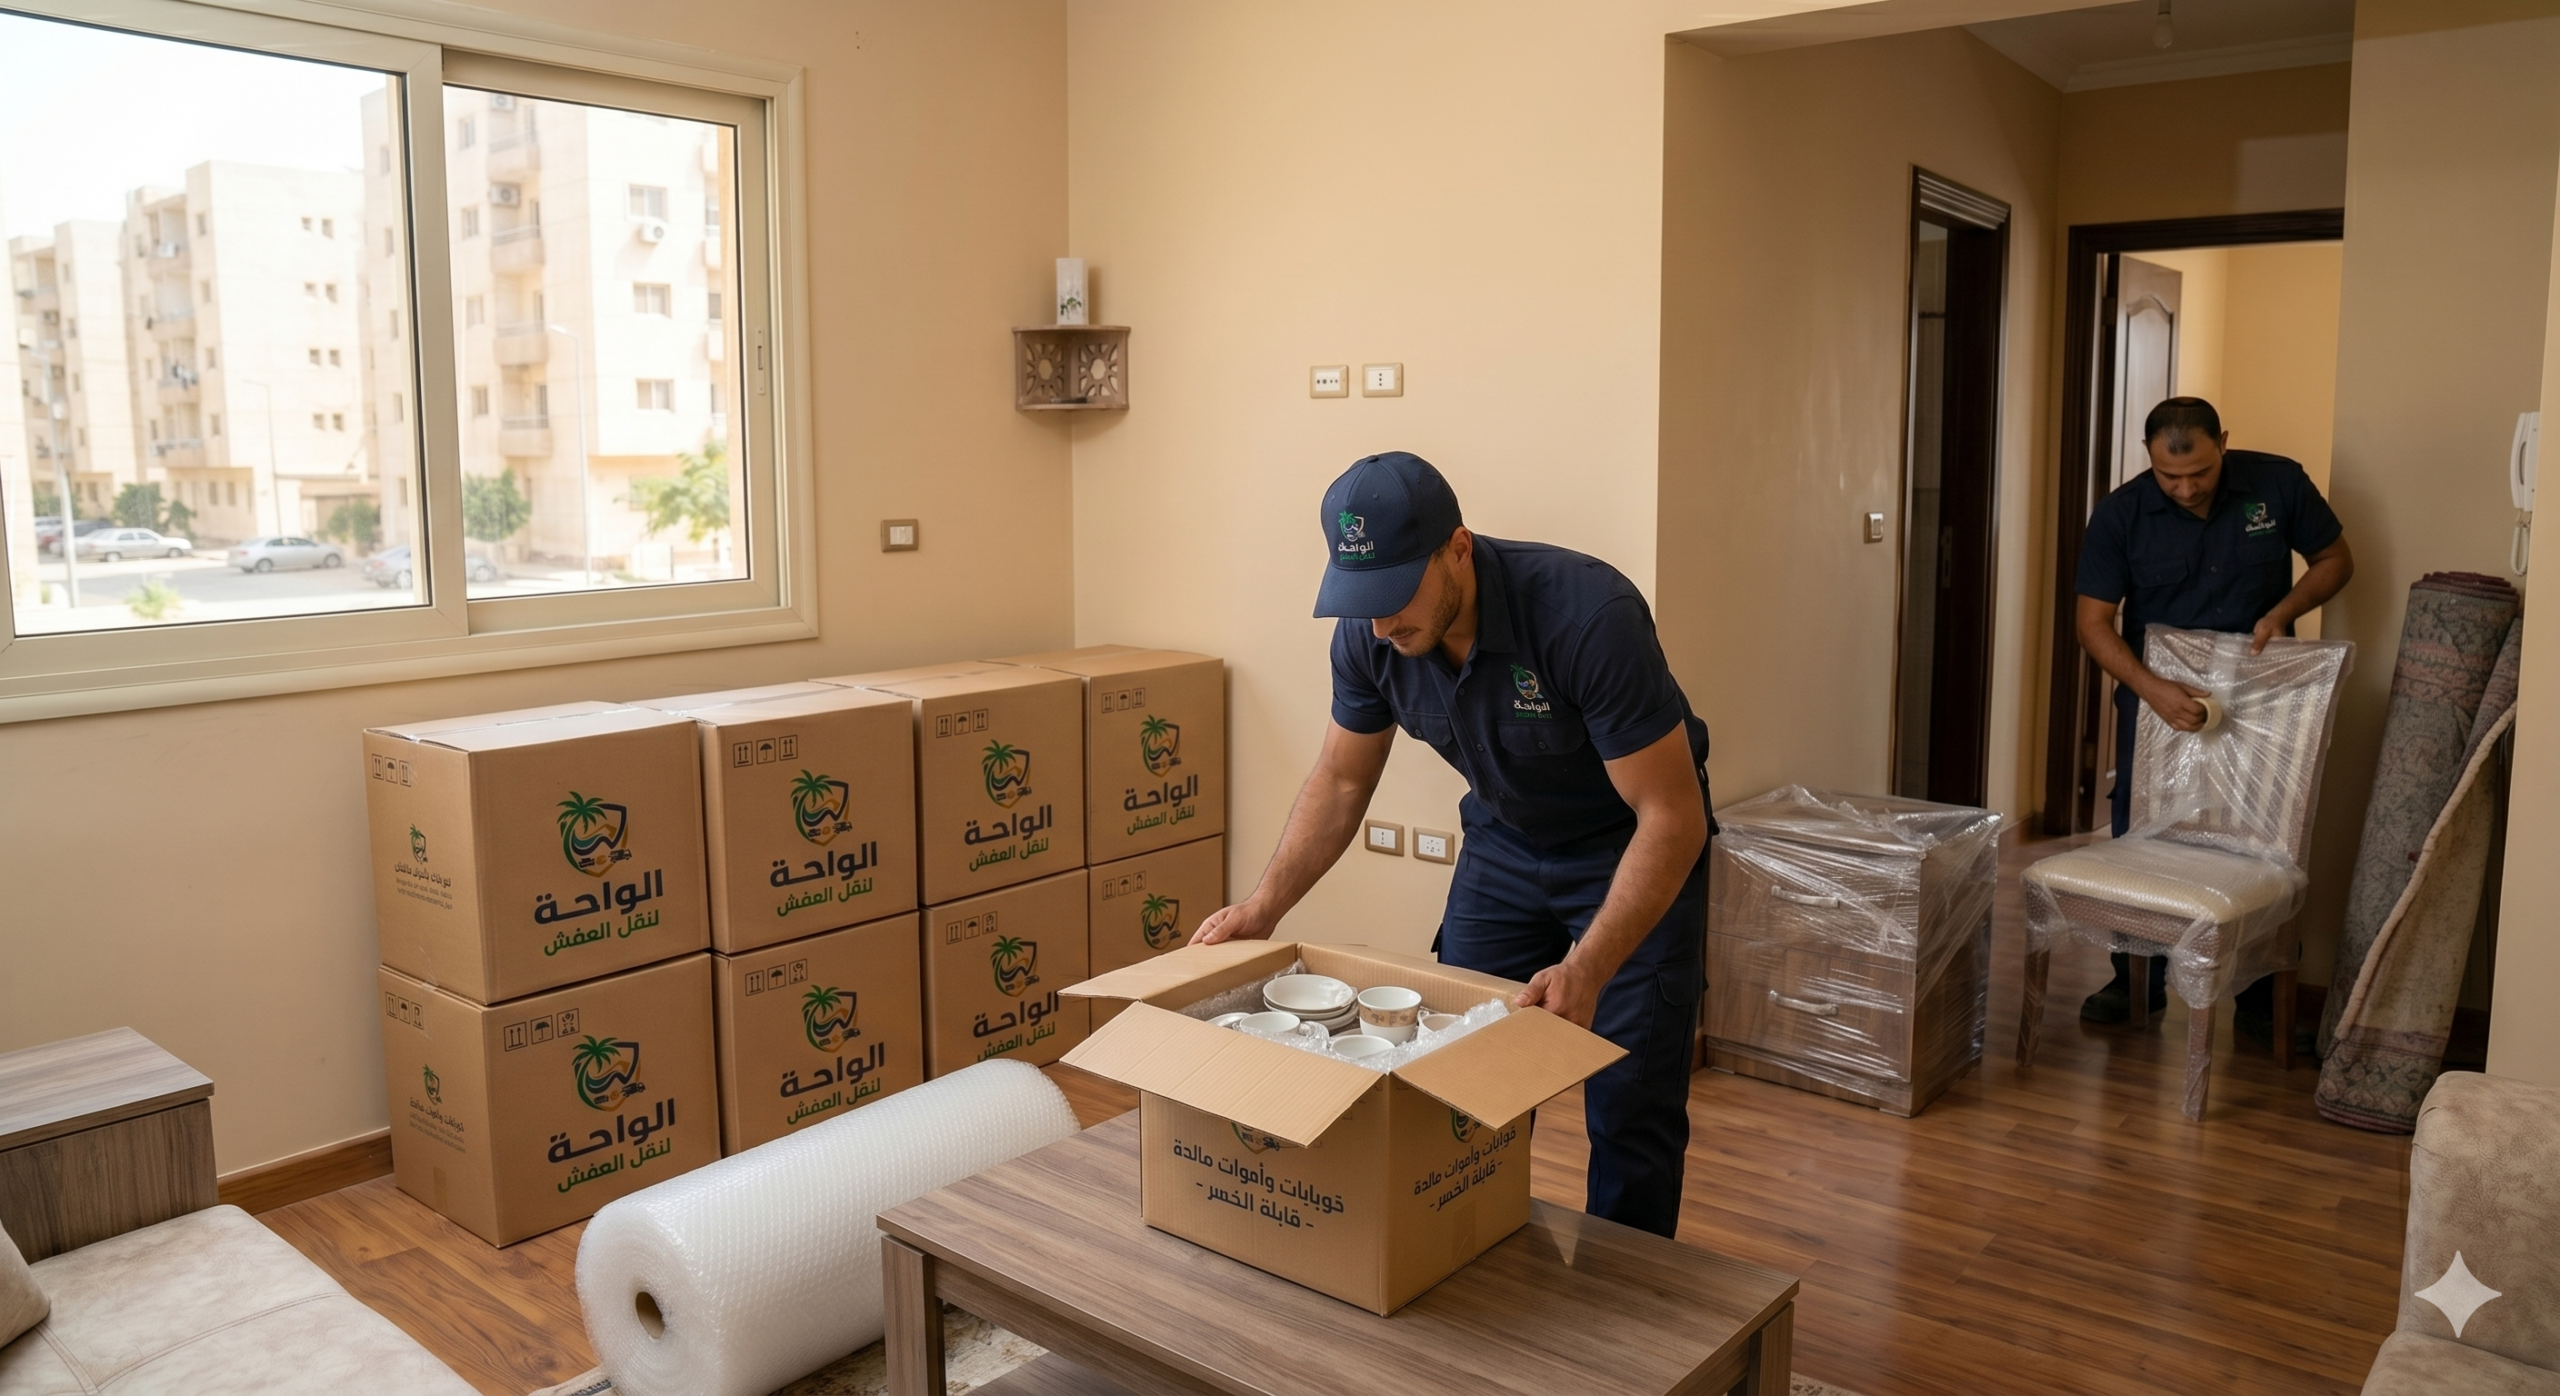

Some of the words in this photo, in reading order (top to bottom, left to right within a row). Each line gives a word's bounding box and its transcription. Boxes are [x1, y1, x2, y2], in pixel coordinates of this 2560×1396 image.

[1123, 773, 1199, 812] الواحة
[963, 803, 1053, 846] الواحة
[1126, 811, 1167, 837] العفش
[1169, 804, 1196, 826] لنقل
[769, 840, 878, 888] الواحة
[968, 844, 1016, 873] العفش
[1019, 837, 1050, 861] لنقل
[533, 868, 664, 925] الواحة
[776, 886, 833, 918] العفش
[836, 876, 874, 903] لنقل
[542, 921, 611, 957] العفش
[616, 908, 661, 939] لنقل
[972, 990, 1060, 1039] الواحة
[1025, 1020, 1056, 1047] لنقل
[779, 1041, 885, 1098] الواحة
[845, 1077, 881, 1106] لنقل
[786, 1090, 842, 1126] العفش
[547, 1097, 676, 1164] الواحة
[628, 1137, 672, 1169] لنقل
[1173, 1138, 1214, 1168] مالدة
[556, 1153, 625, 1194] العفش
[1259, 1198, 1301, 1229] قابلة
